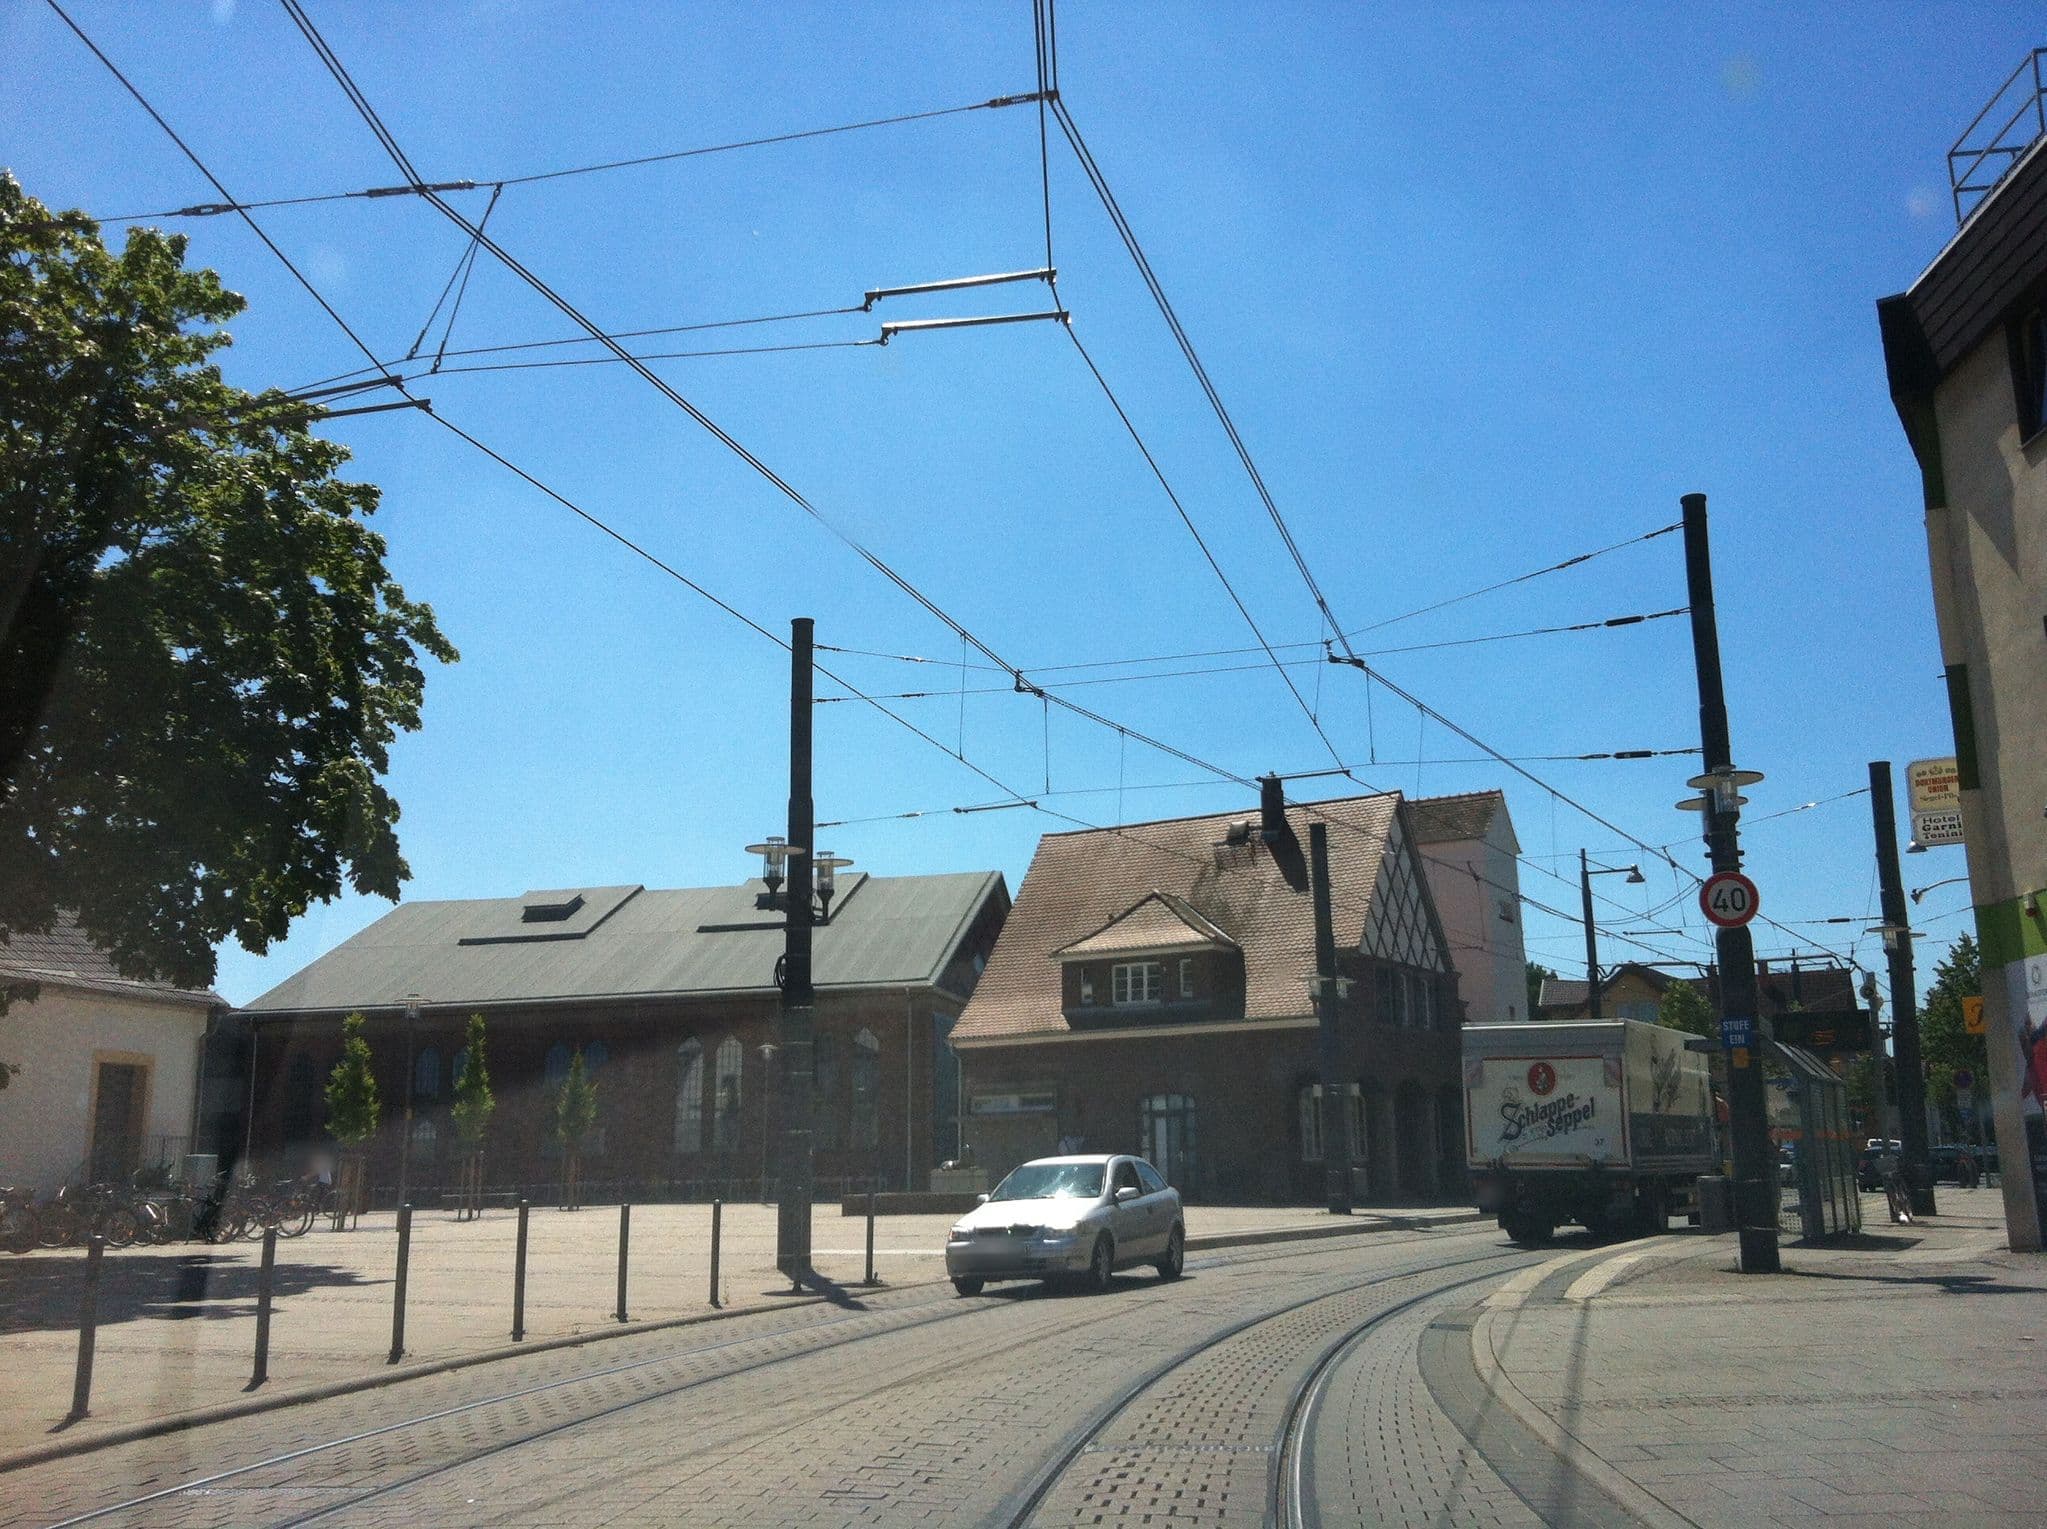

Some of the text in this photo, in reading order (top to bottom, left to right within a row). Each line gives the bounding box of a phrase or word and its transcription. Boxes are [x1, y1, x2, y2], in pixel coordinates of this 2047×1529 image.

[1923, 814, 1960, 824] Hotel
[1922, 822, 1963, 832] Garni
[1713, 887, 1746, 912] 40
[1723, 1020, 1749, 1031] STUFE
[1729, 1034, 1745, 1044] EIN
